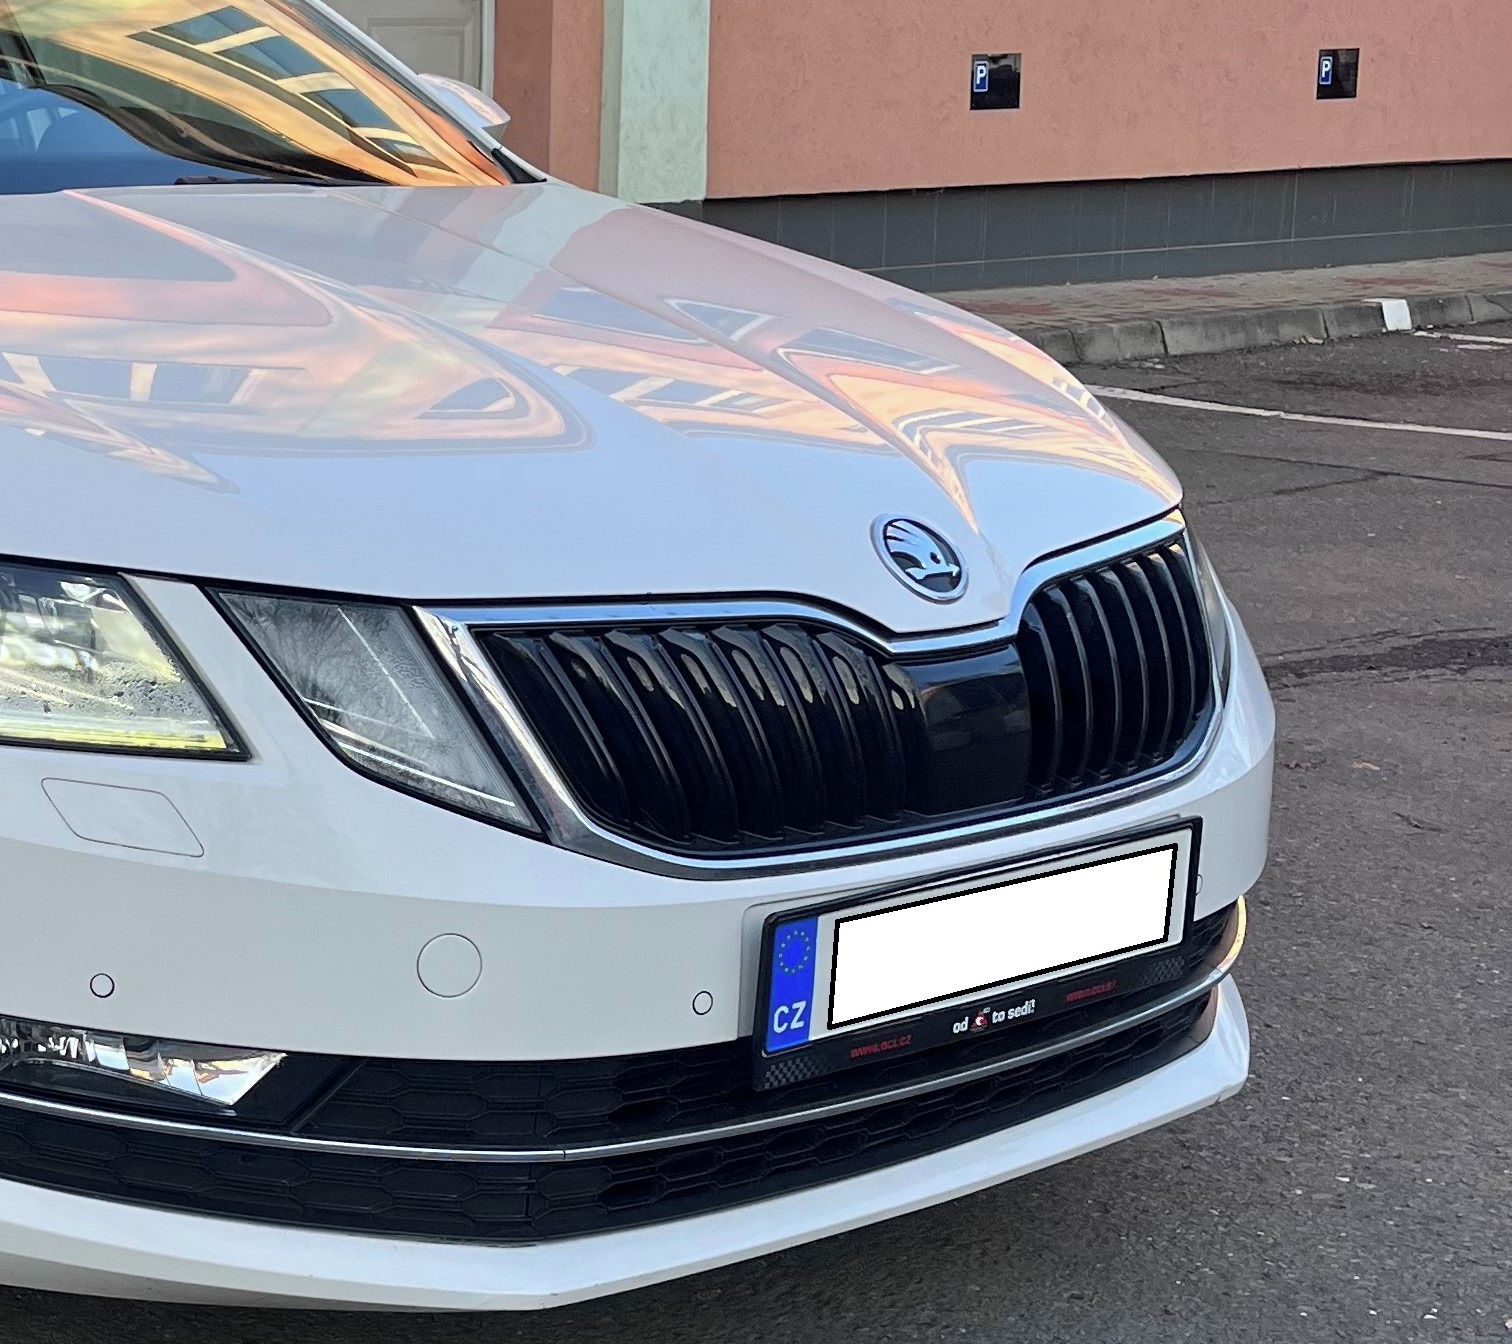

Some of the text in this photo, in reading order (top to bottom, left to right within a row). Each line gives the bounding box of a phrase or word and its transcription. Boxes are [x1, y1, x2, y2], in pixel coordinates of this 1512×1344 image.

[976, 65, 987, 84] P
[1322, 60, 1331, 78] P
[773, 1000, 807, 1034] CZ
[952, 1016, 969, 1034] od
[992, 1011, 1006, 1024] to
